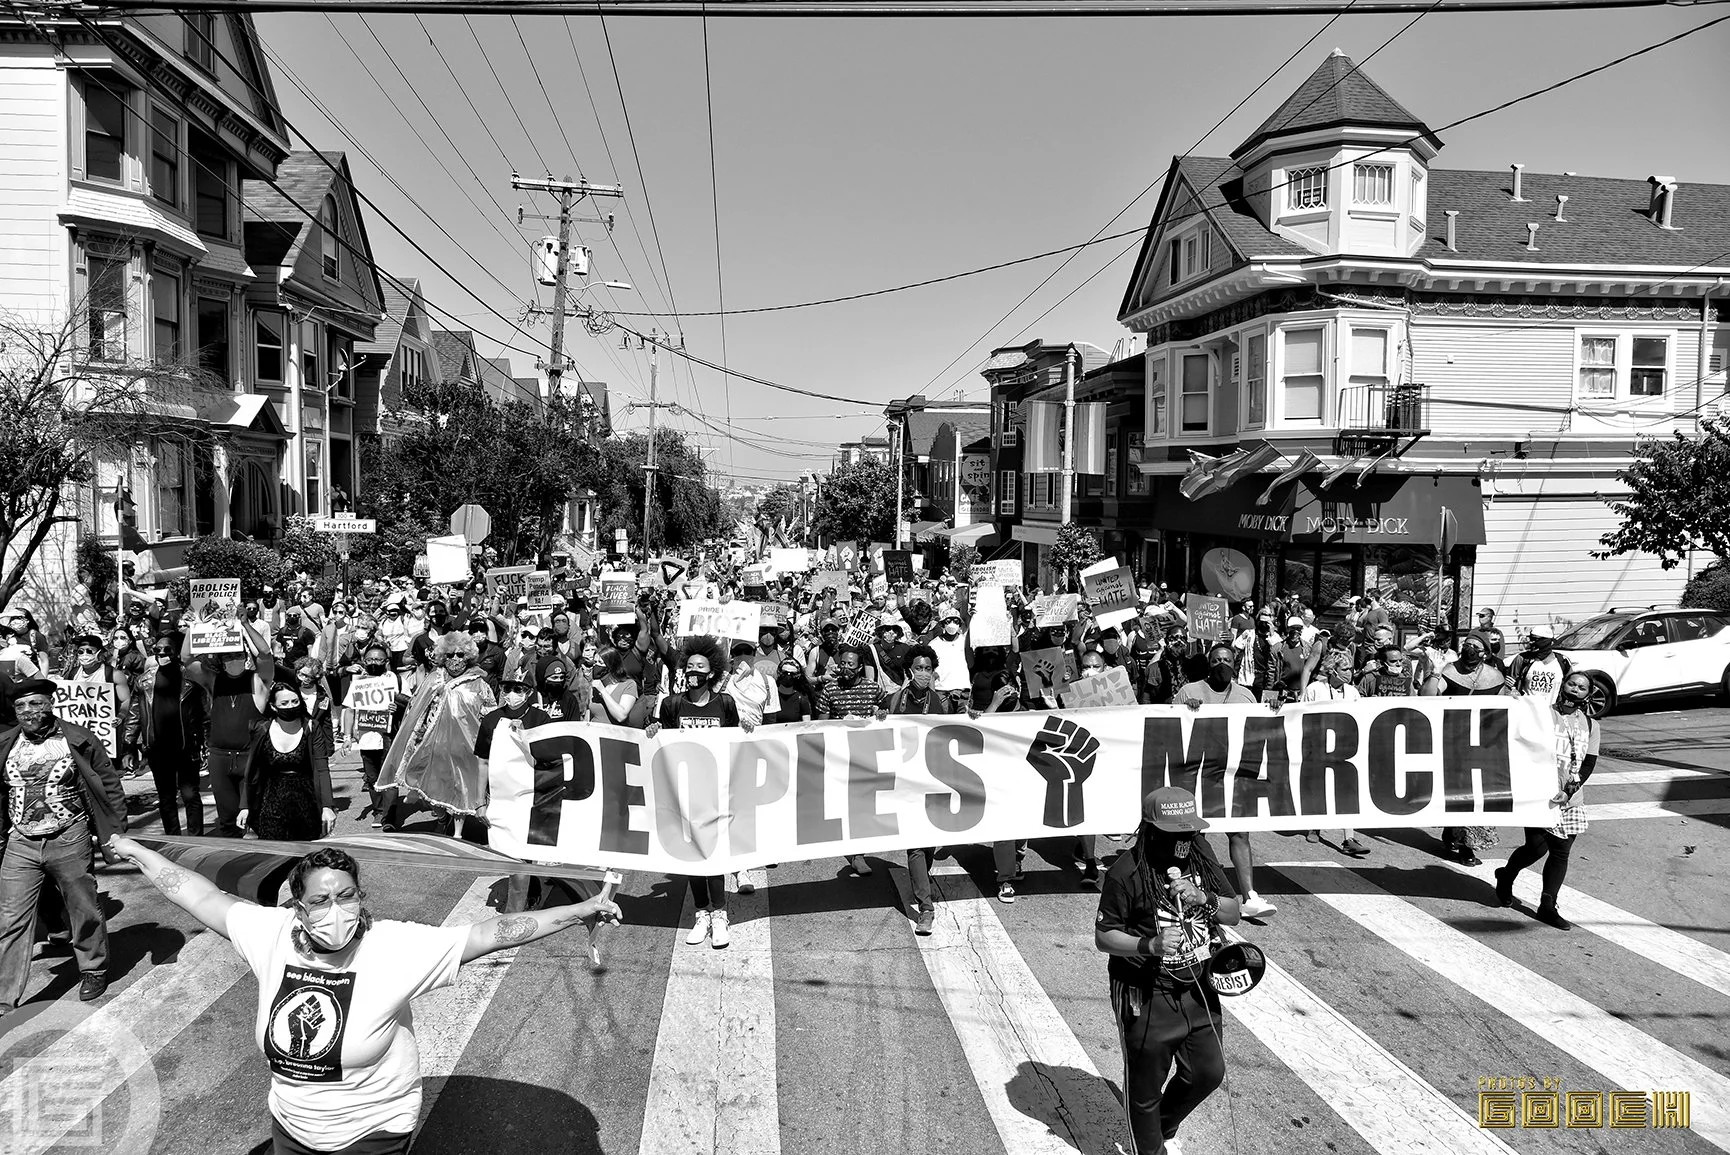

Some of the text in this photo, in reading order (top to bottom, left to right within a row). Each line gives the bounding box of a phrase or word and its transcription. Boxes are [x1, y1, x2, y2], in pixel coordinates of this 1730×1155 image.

[968, 472, 989, 482] spin
[324, 521, 368, 530] Hartford
[1238, 514, 1289, 532] MOBY DICK
[1306, 517, 1410, 535] MOBY DICK
[494, 573, 527, 585] FUCK
[888, 566, 909, 577] HATE
[191, 583, 238, 592] ABOLISH
[605, 591, 628, 599] LIVES
[1099, 589, 1128, 608] HATE
[688, 614, 747, 634] RIOT
[1195, 617, 1222, 633] HATE
[1530, 681, 1553, 690] LIVES
[1532, 675, 1555, 684] GAY
[55, 685, 110, 703] BLACK
[352, 686, 395, 708] RIOT
[54, 703, 112, 719] TRANS
[527, 707, 1512, 863] PEOPLE'S MARCH
[286, 971, 302, 980] see
[302, 972, 325, 985] black
[1214, 973, 1249, 991] RESIST
